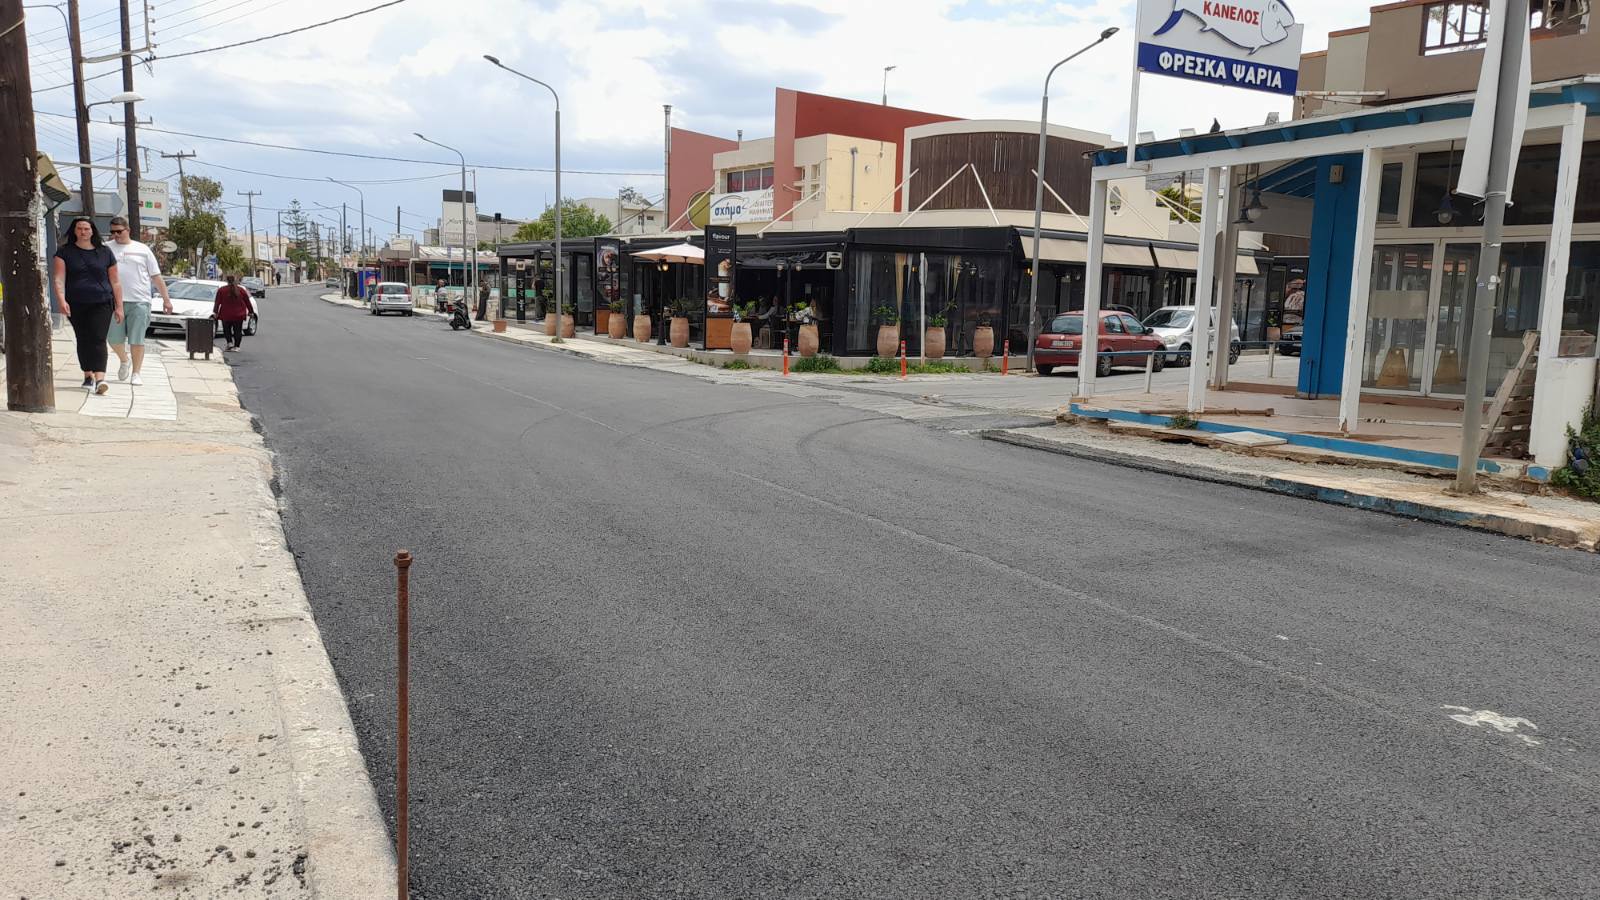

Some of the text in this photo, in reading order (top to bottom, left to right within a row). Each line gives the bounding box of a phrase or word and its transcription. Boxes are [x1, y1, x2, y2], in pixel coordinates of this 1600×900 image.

[1203, 1, 1259, 25] ΚΑΝΕΛΟΣ
[1159, 51, 1282, 88] ΦΡΕΣΚΑ ΨΑΡΙΑ
[714, 202, 741, 220] σχήμα
